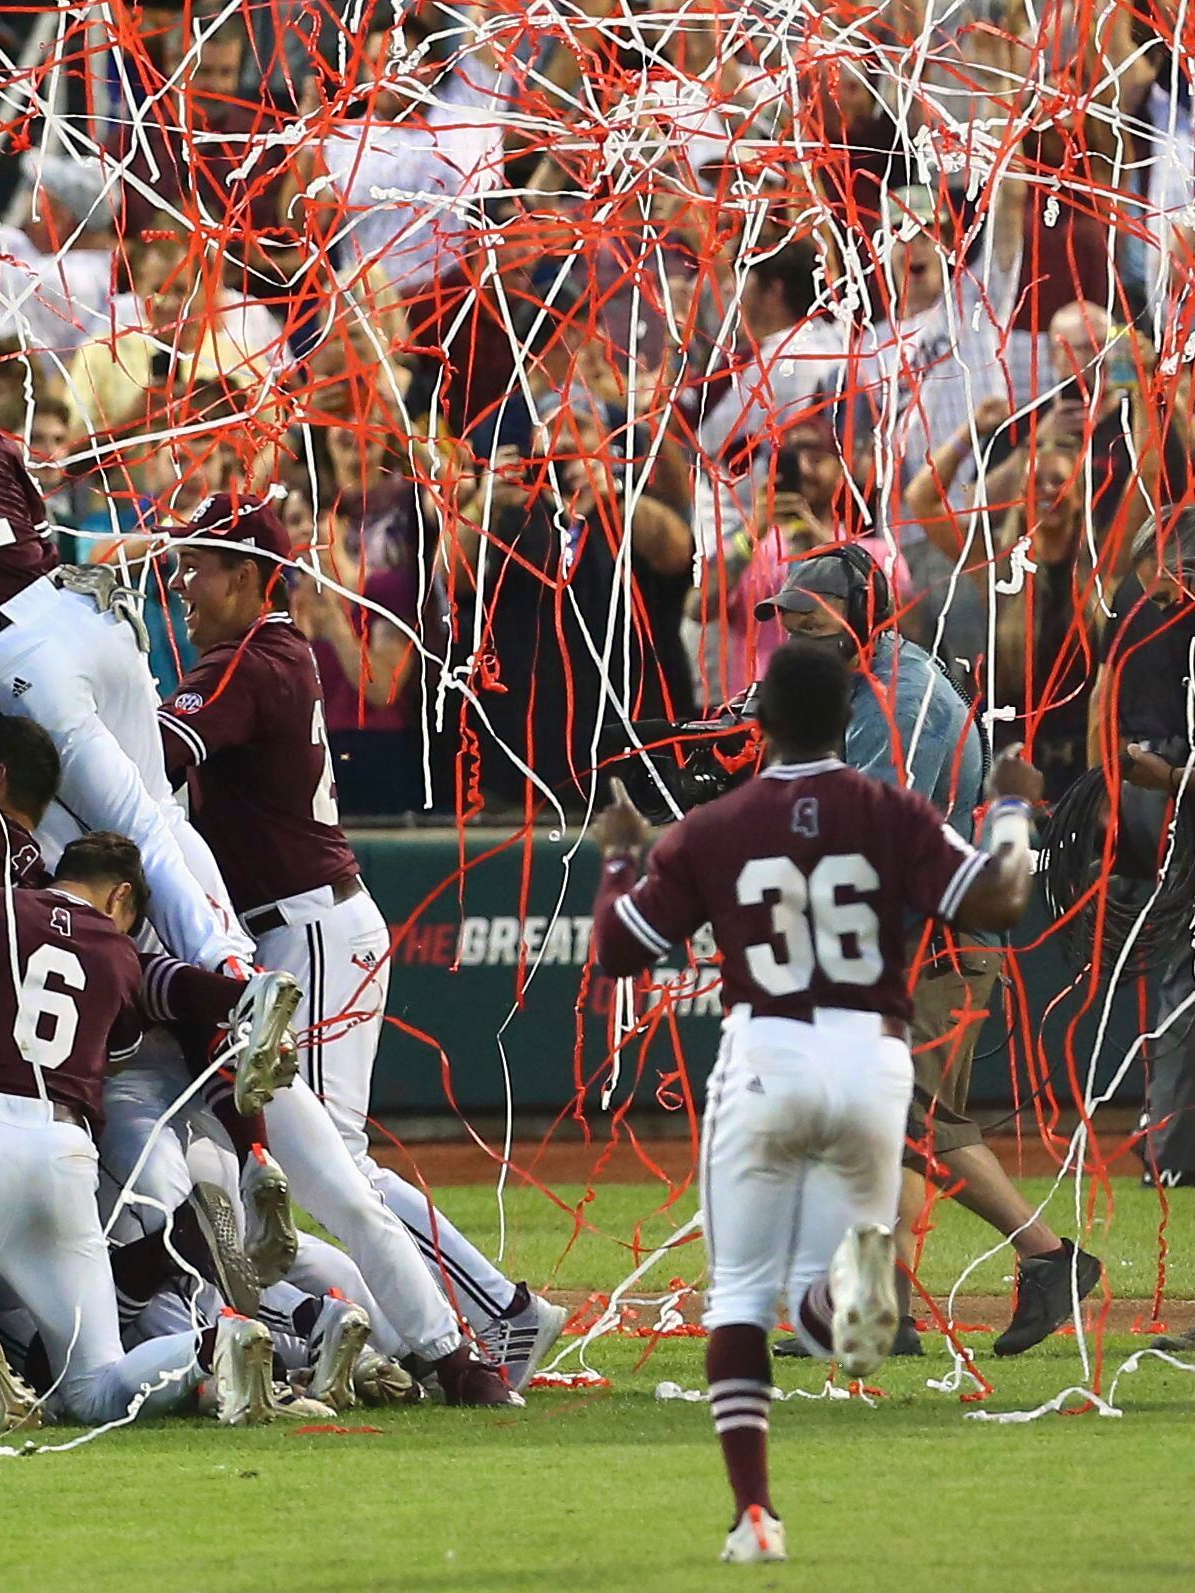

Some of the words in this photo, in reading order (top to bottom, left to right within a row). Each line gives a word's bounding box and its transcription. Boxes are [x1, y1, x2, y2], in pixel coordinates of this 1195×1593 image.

[389, 924, 456, 966] THE
[736, 853, 884, 997] 36
[13, 943, 87, 1069] 6
